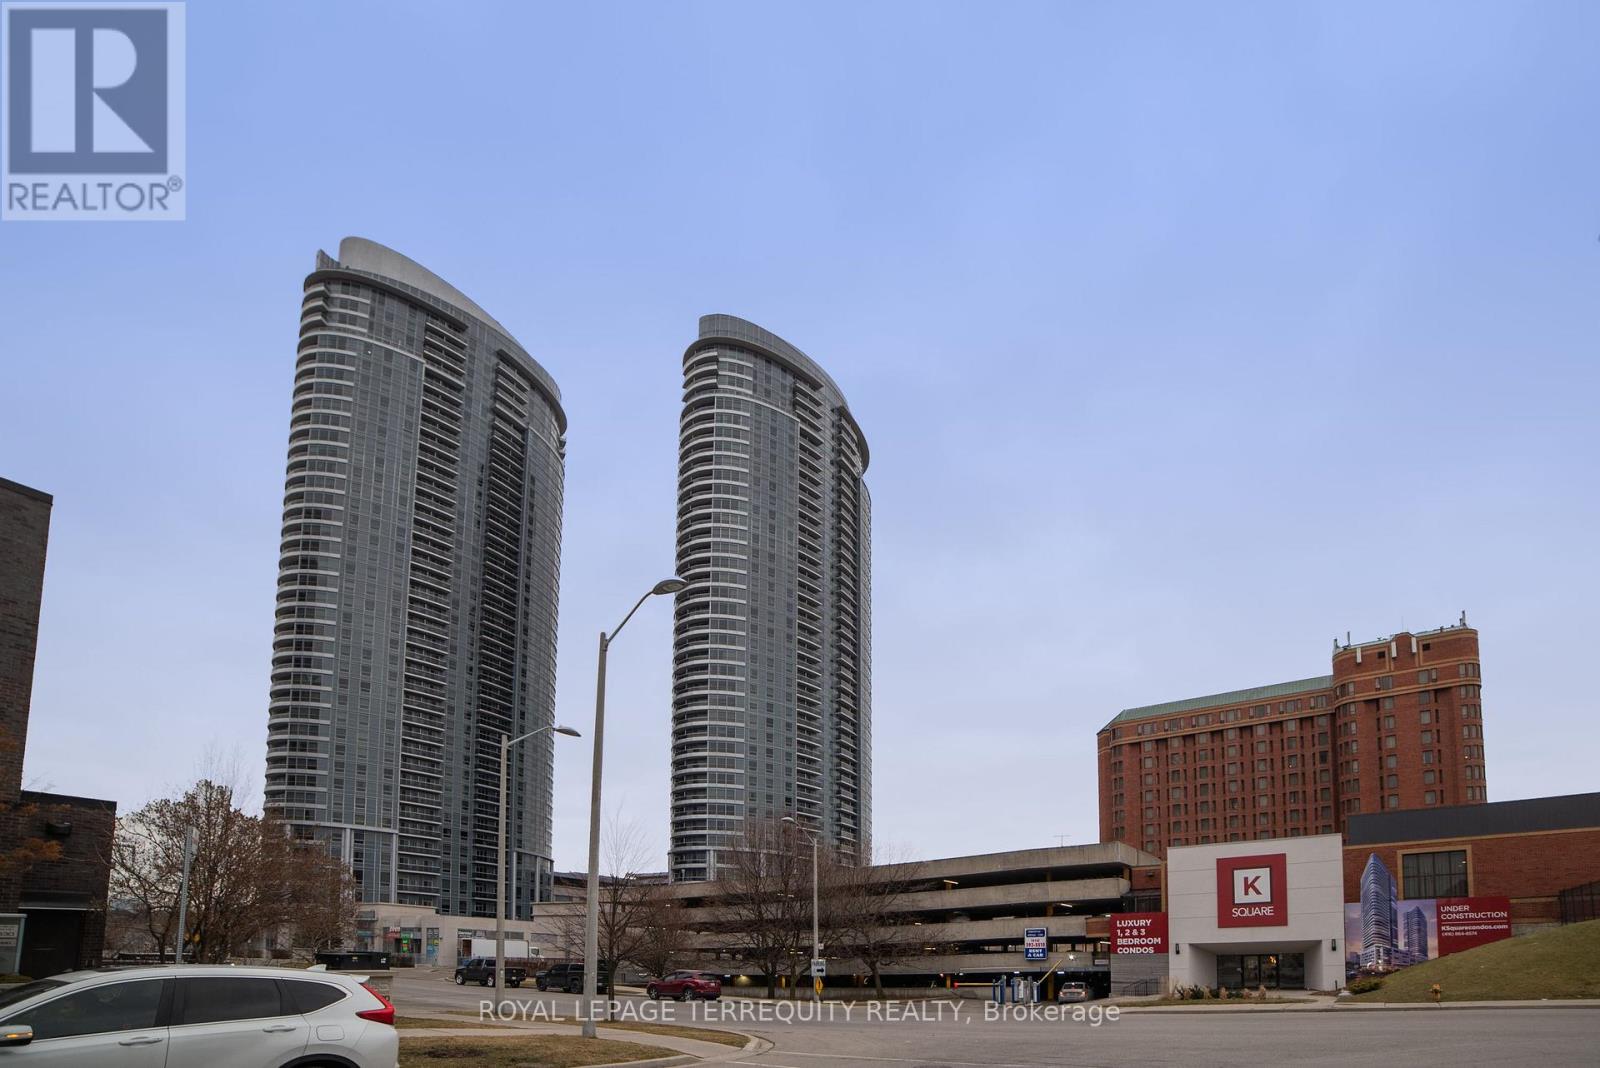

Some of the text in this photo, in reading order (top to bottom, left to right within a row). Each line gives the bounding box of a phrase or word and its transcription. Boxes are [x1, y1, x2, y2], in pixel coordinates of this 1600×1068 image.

[1243, 875, 1263, 896] K
[1231, 906, 1275, 918] SQUARE
[1440, 911, 1508, 919] CONSTRUCTION
[1116, 919, 1152, 927] LUXURY
[1116, 929, 1123, 937] 1,
[1116, 937, 1161, 945] BEDROOM
